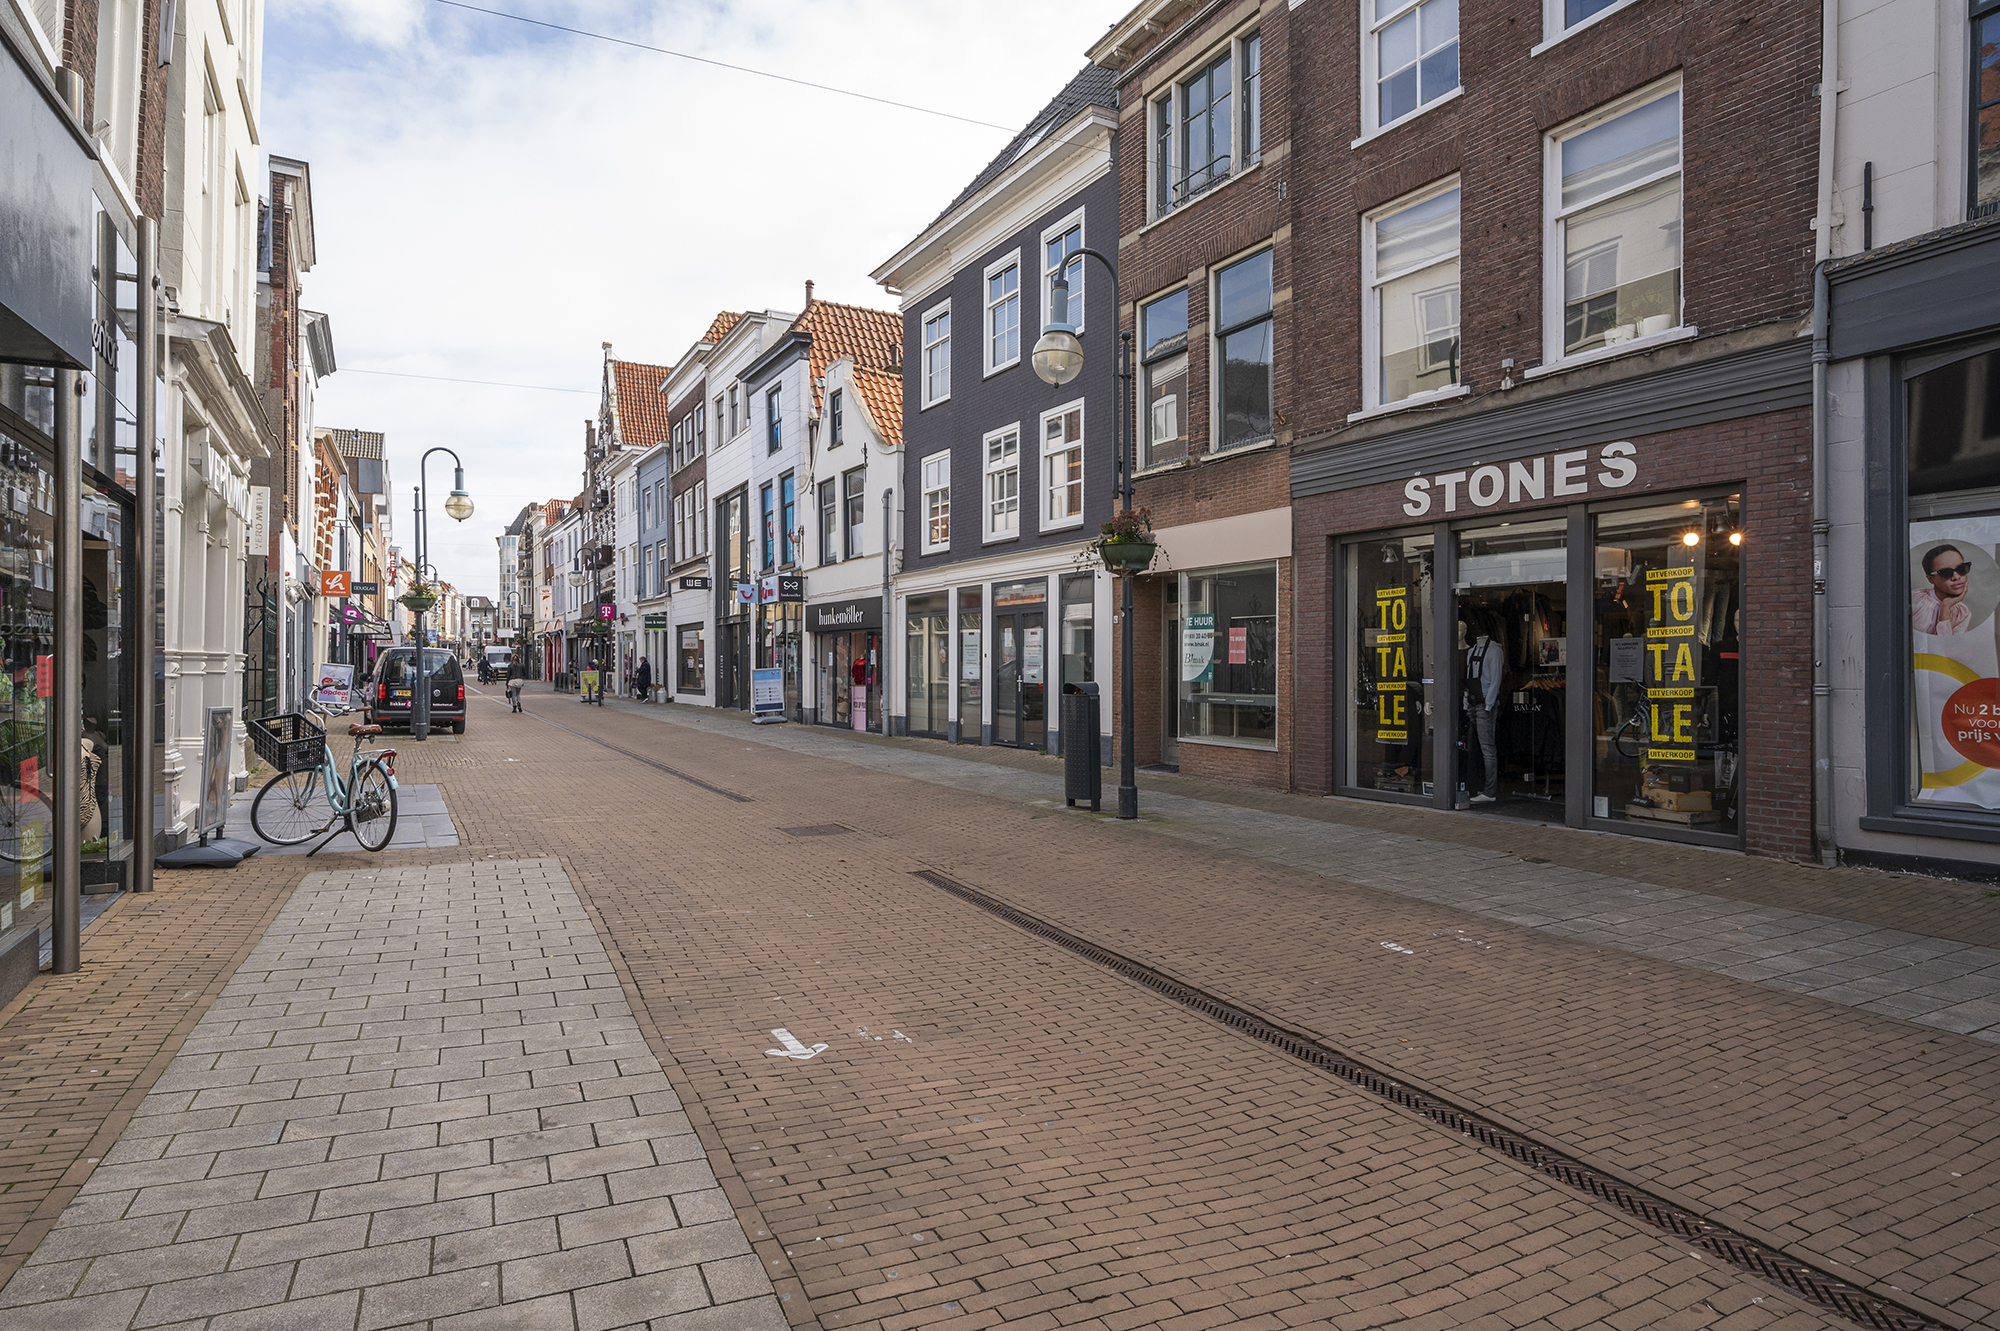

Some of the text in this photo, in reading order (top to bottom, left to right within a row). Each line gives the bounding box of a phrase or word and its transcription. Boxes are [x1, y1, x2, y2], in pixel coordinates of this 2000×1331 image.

[207, 443, 232, 504] VERO
[1402, 441, 1628, 517] STONES
[255, 492, 264, 550] VERO MODA
[388, 552, 397, 585] HEMA
[1648, 569, 1693, 579] UITVERKOOP
[686, 579, 702, 587] WE
[1377, 588, 1405, 597] UITVERKOOP
[1645, 581, 1694, 622] TO
[818, 604, 864, 626] hunkemöller
[1185, 616, 1214, 626] TE HUUR
[1376, 599, 1406, 630] TO
[1377, 634, 1406, 642] UITVERKOOP
[1648, 627, 1693, 636] UITVERKOOP
[1376, 647, 1407, 677] TA
[1647, 643, 1695, 681] TA
[1649, 689, 1693, 697] UITVERKOOP
[1379, 695, 1406, 725] LE
[1954, 704, 1975, 715] Nu
[1979, 704, 1988, 715] 2
[1650, 704, 1692, 742] LE
[1957, 729, 1992, 743] prijs
[1649, 750, 1694, 759] UITVERKOOP
